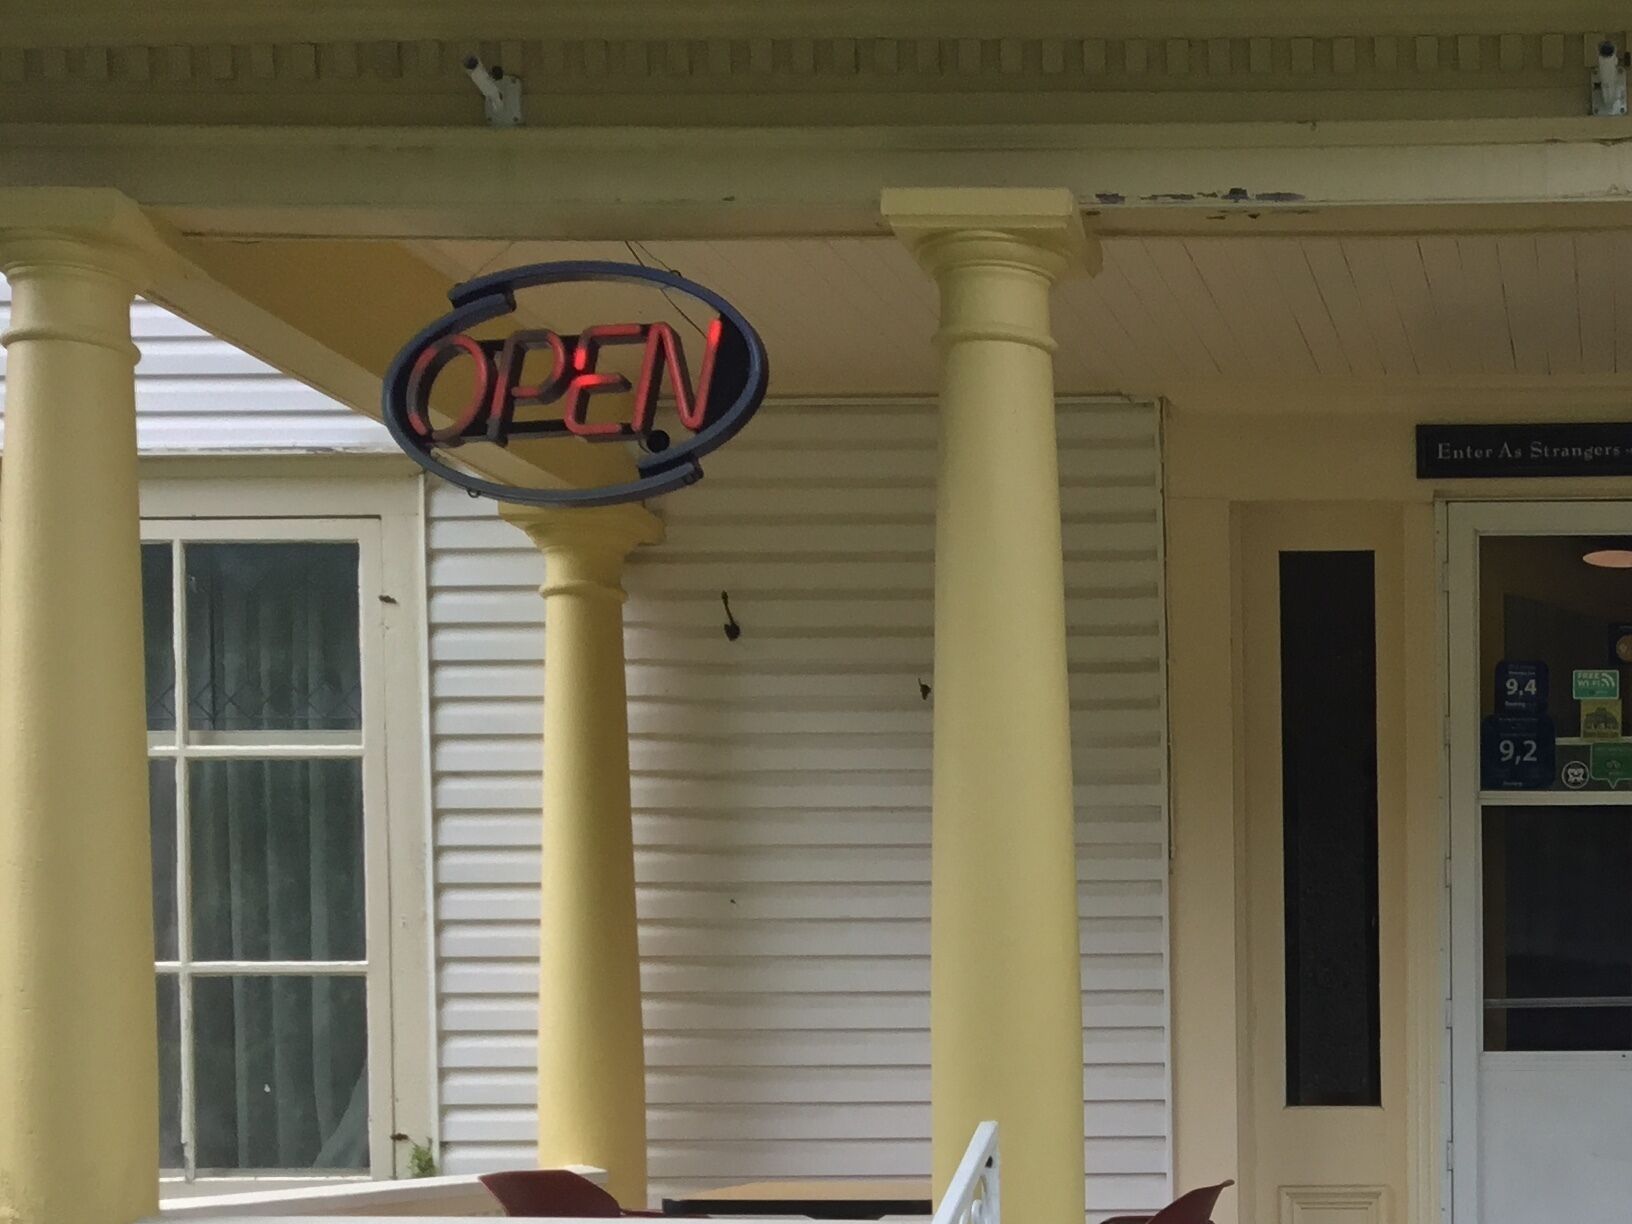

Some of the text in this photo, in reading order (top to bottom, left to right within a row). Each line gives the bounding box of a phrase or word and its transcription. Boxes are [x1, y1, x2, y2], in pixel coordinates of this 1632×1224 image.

[405, 317, 723, 442] OPEN
[1437, 442, 1493, 460] Enter
[1499, 441, 1522, 458] As
[1530, 440, 1621, 462] Strangers
[1499, 740, 1538, 765] 9,2
